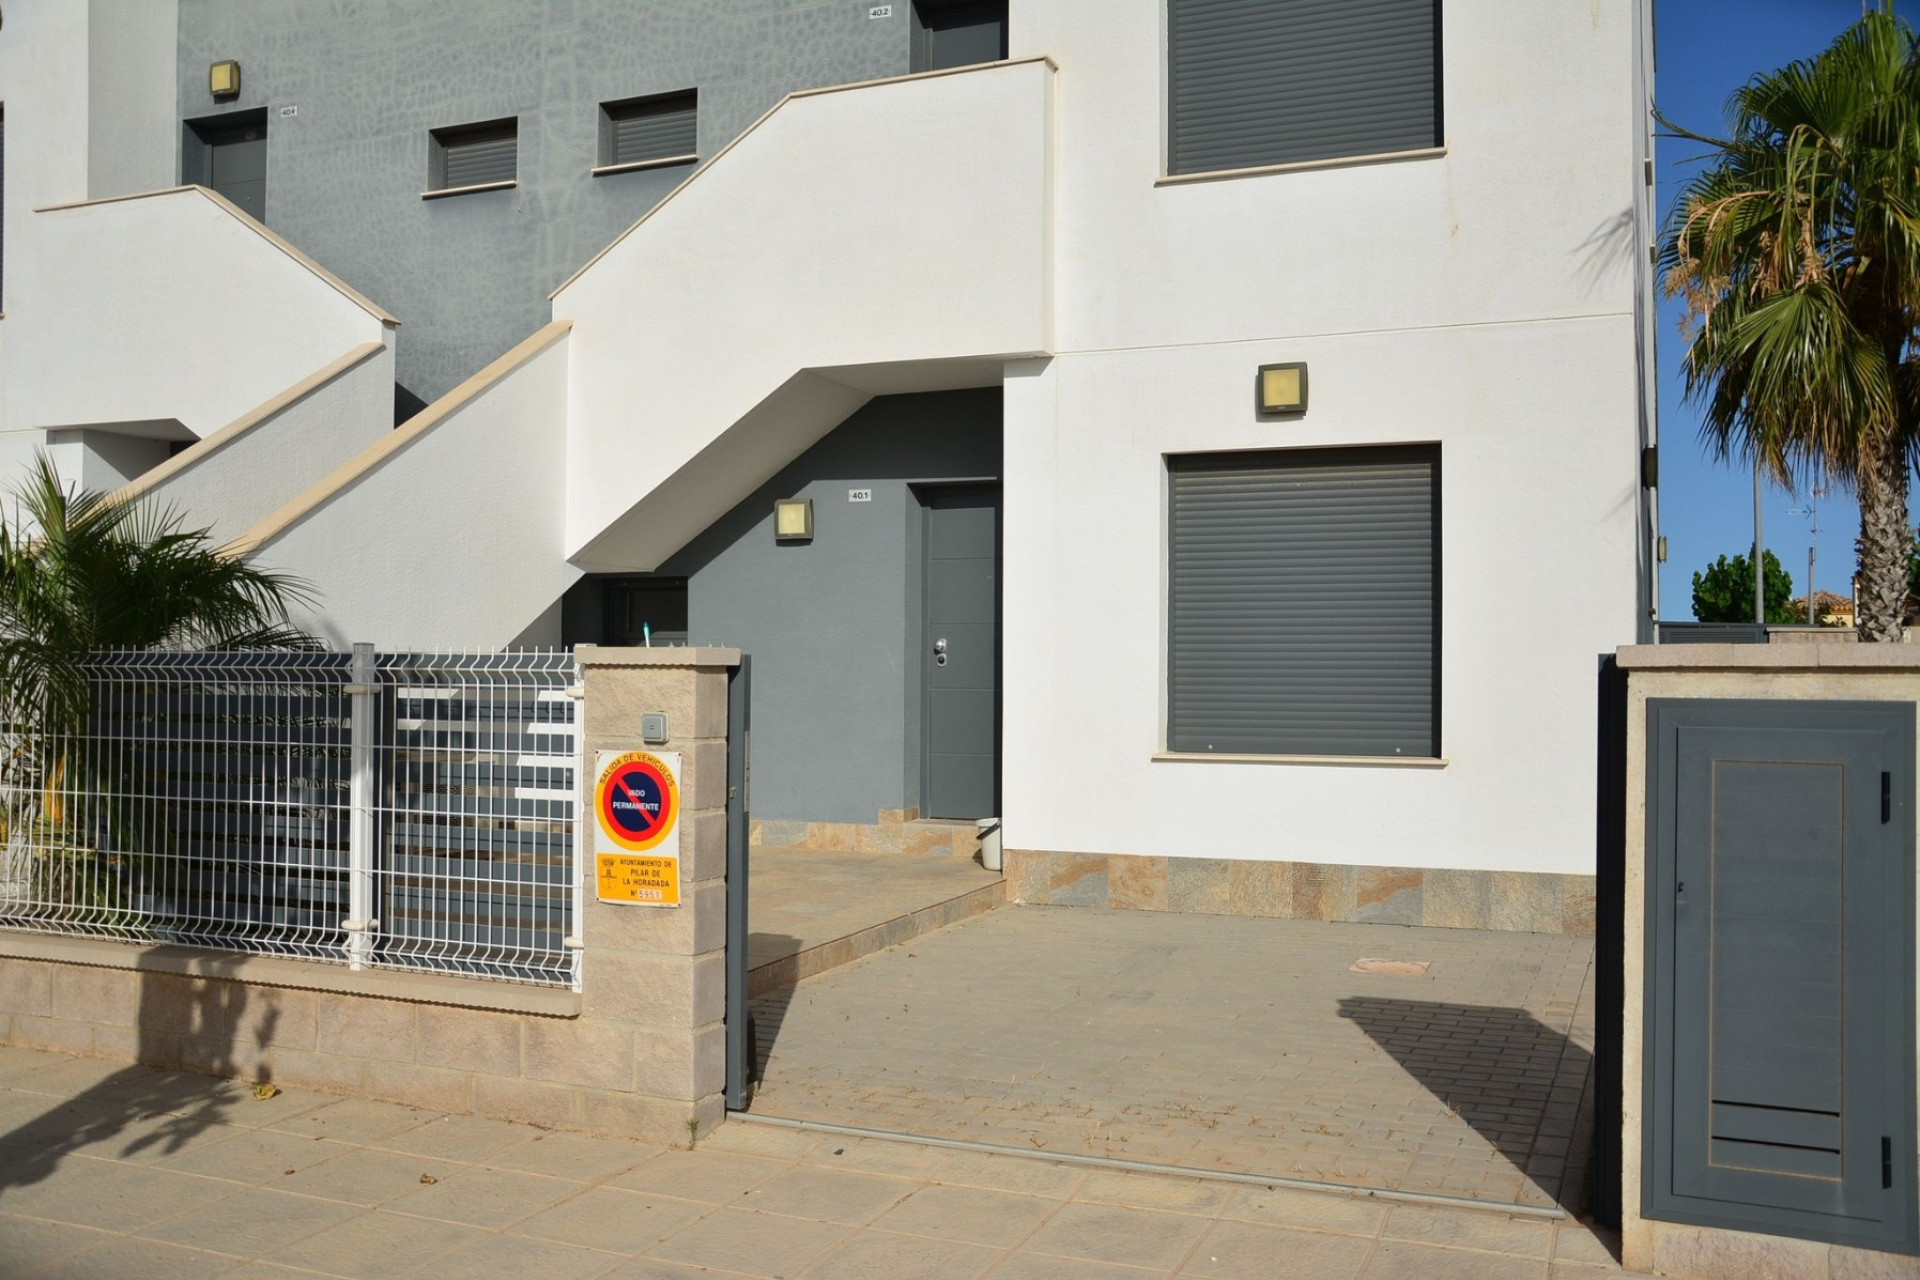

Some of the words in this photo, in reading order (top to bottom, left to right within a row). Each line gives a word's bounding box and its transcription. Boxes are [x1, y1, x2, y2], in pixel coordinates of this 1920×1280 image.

[600, 759, 622, 784] SALIDA
[623, 753, 634, 761] DE
[627, 789, 646, 797] VADO
[613, 801, 660, 811] PERMANENTE
[619, 859, 662, 868] AYUNTAMIENTO
[630, 868, 649, 877] PILAR
[633, 878, 670, 887] HORADADA
